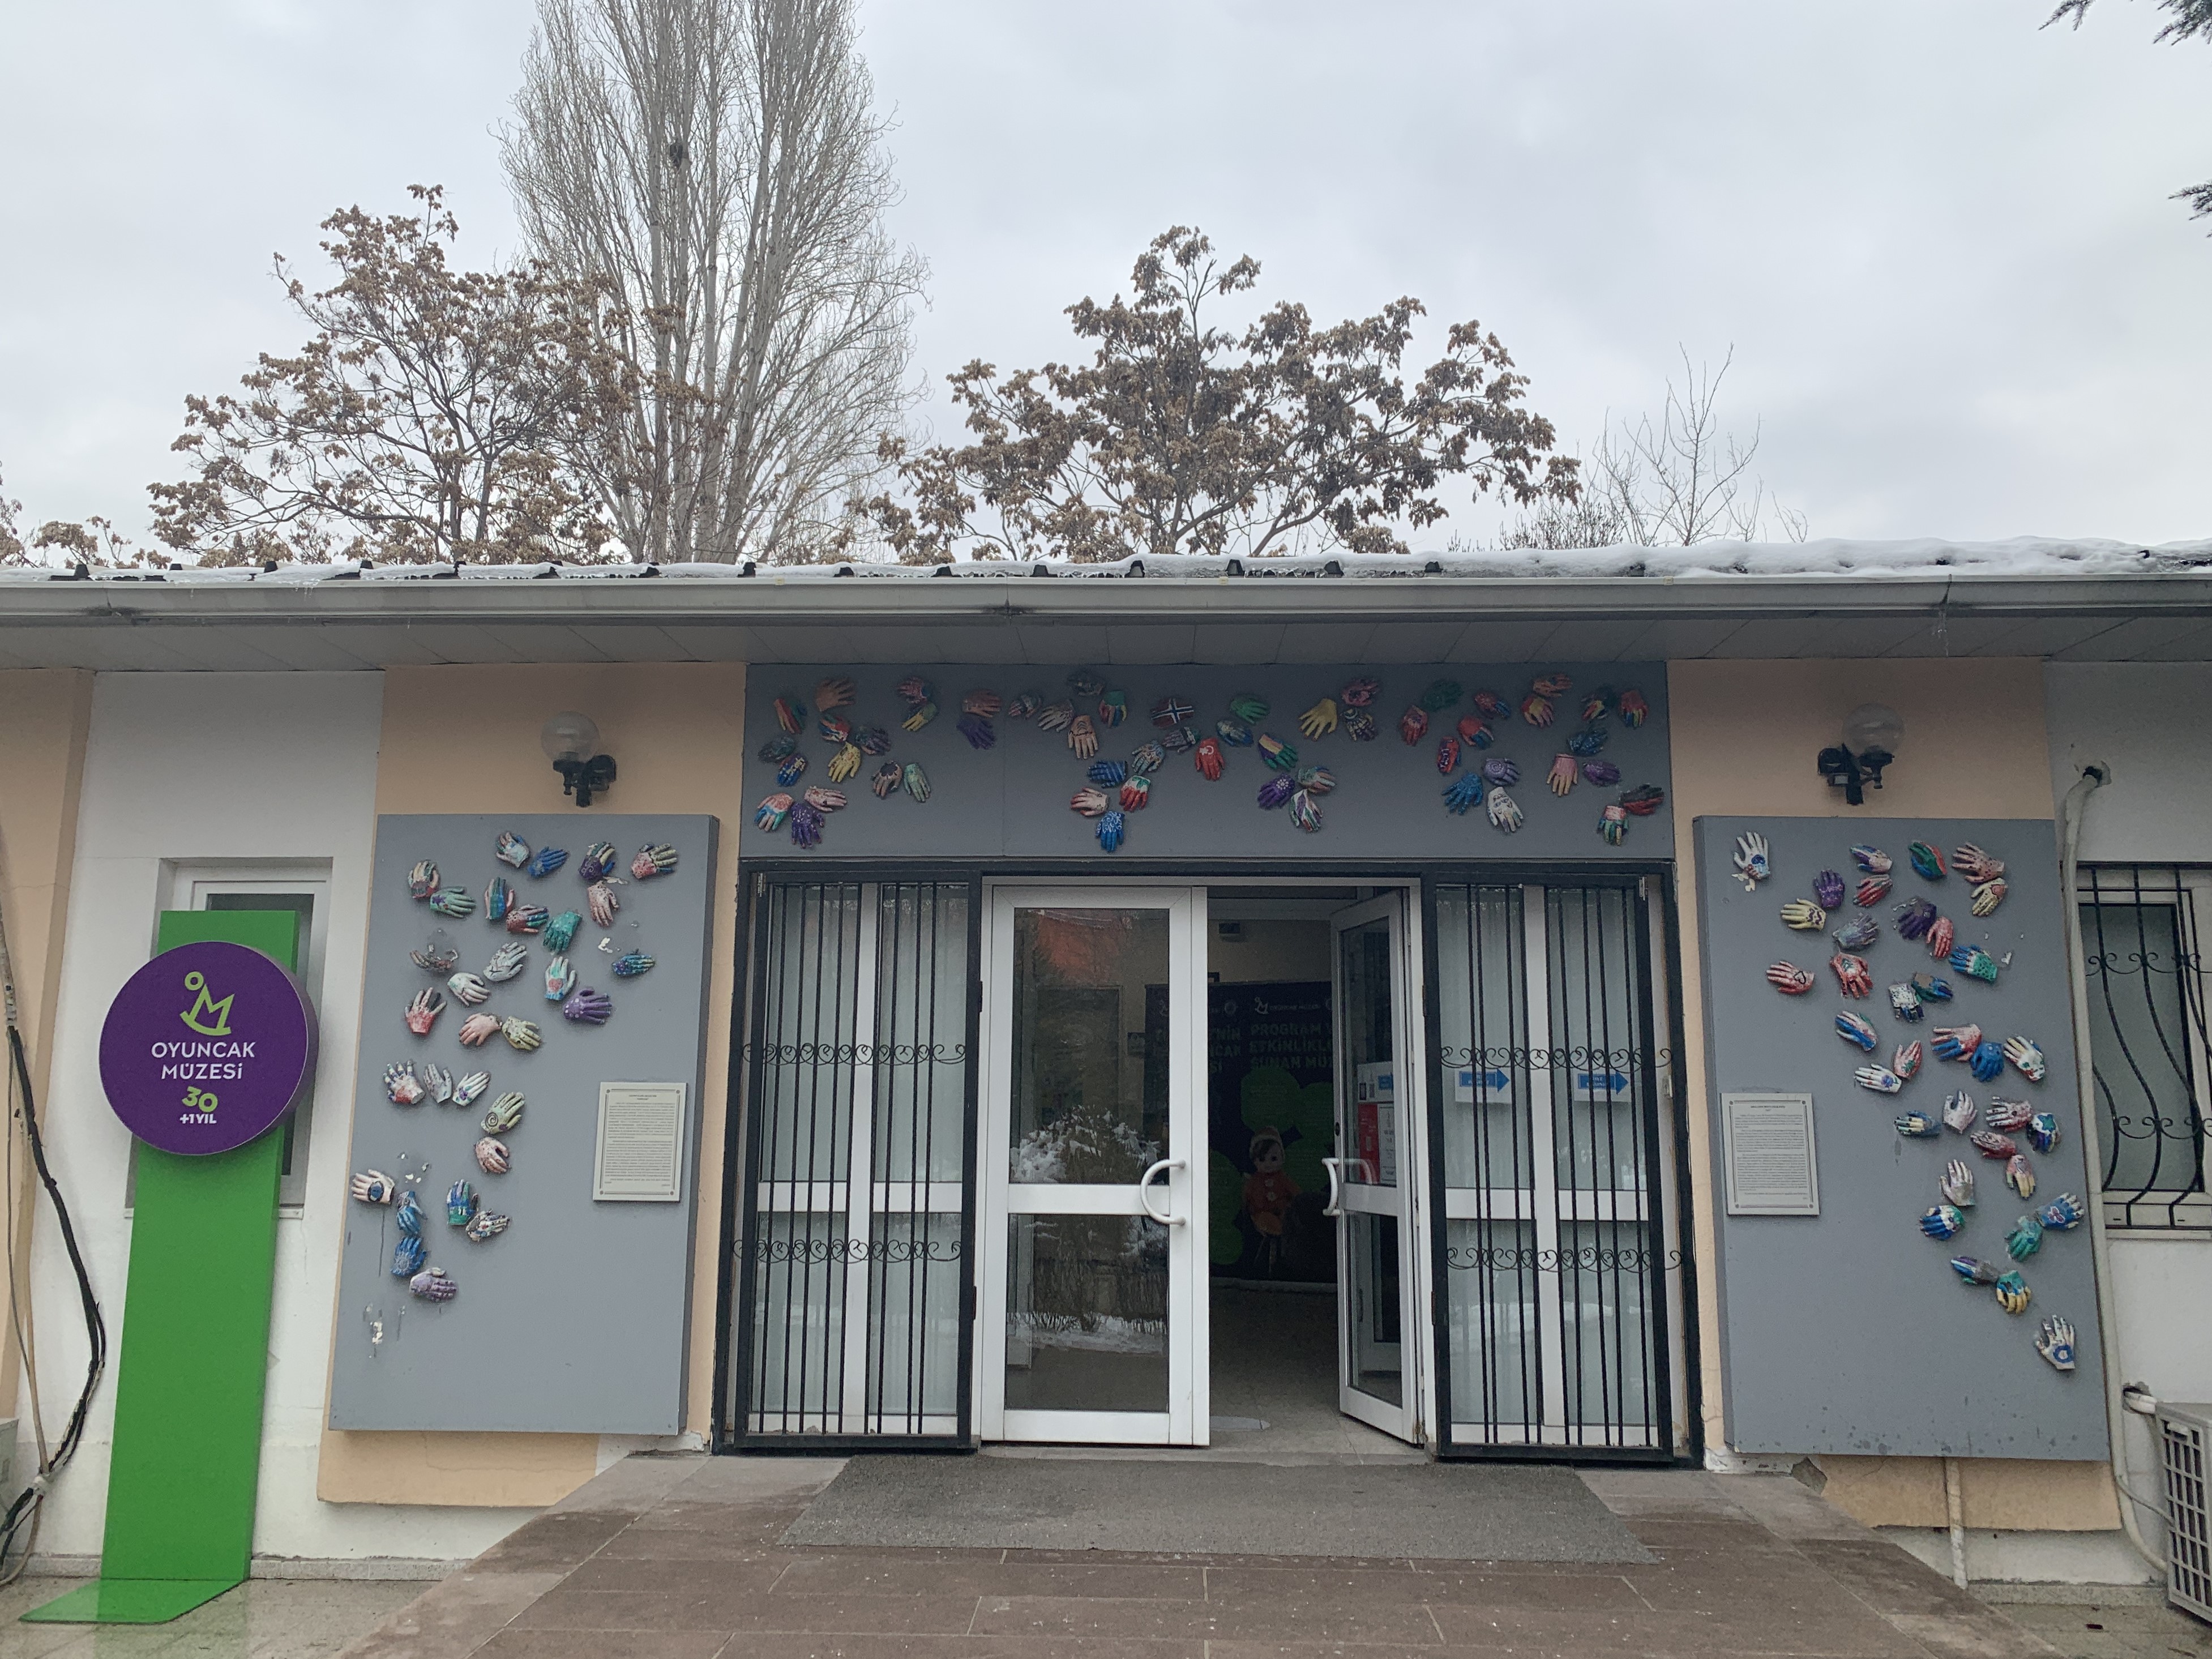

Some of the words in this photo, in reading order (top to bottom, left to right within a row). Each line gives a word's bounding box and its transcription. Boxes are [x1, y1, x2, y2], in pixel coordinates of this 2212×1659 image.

[151, 1042, 255, 1058] OYUNCAK
[161, 1063, 242, 1079] MÜZESİ
[182, 1086, 219, 1113] 30
